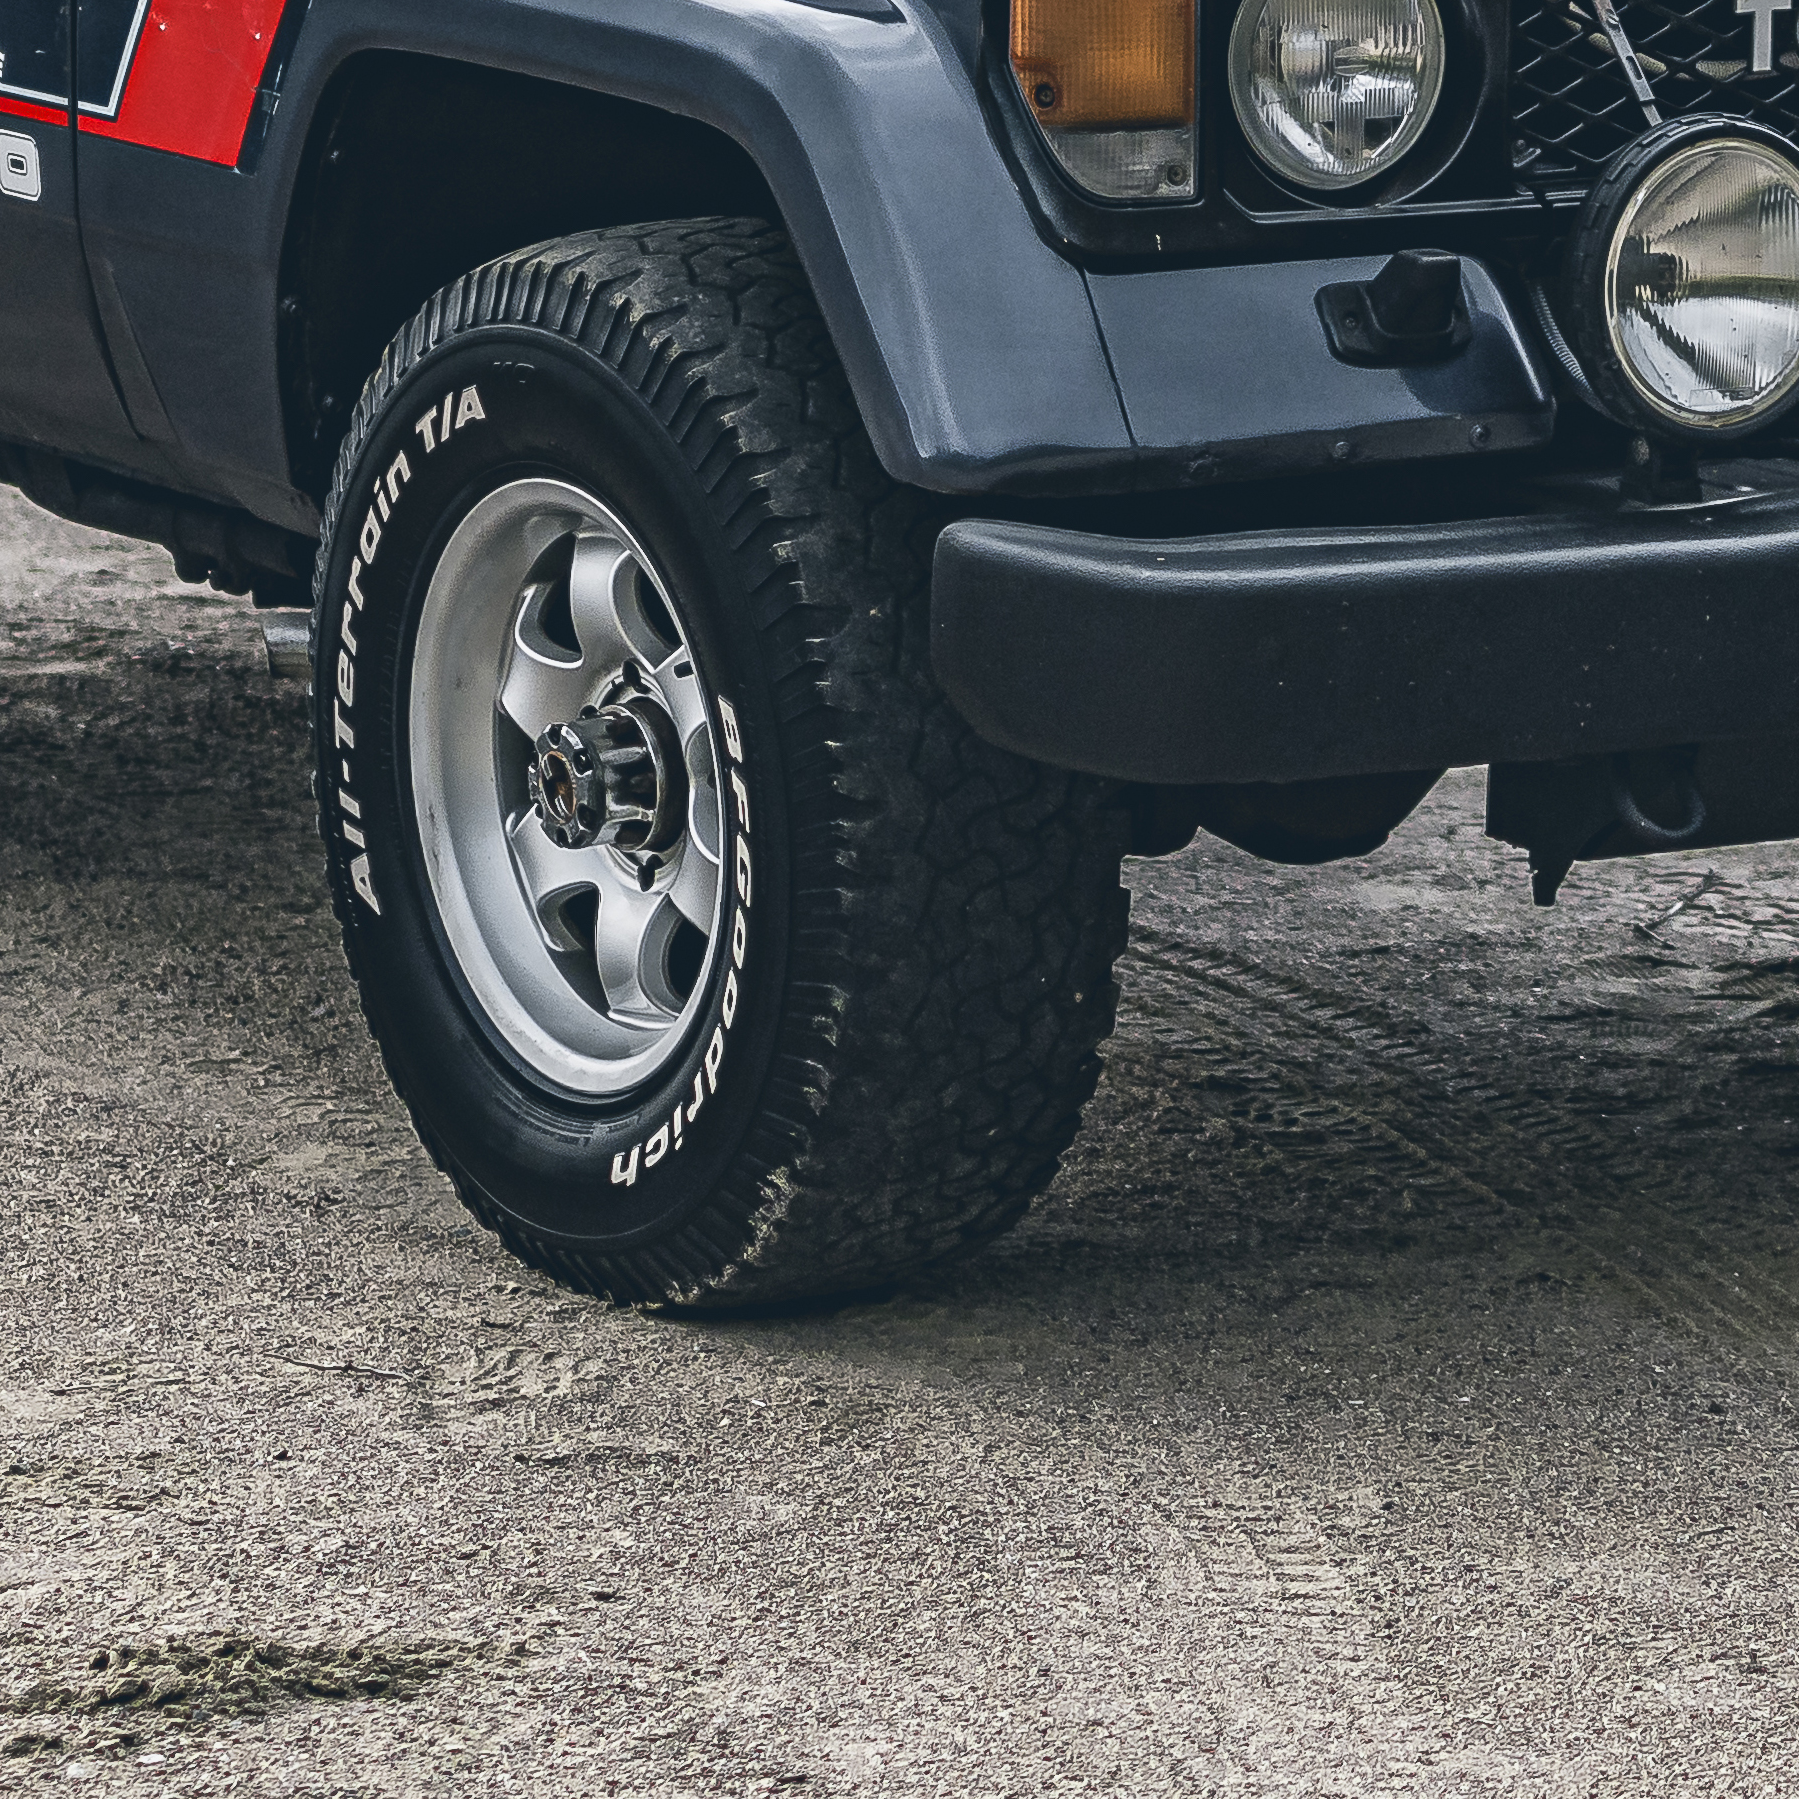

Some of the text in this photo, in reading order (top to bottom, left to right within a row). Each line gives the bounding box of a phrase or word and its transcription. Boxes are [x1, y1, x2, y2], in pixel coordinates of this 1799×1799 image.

[334, 384, 487, 916] All-Terrain T/A
[610, 694, 752, 1188] BFGoodrich
